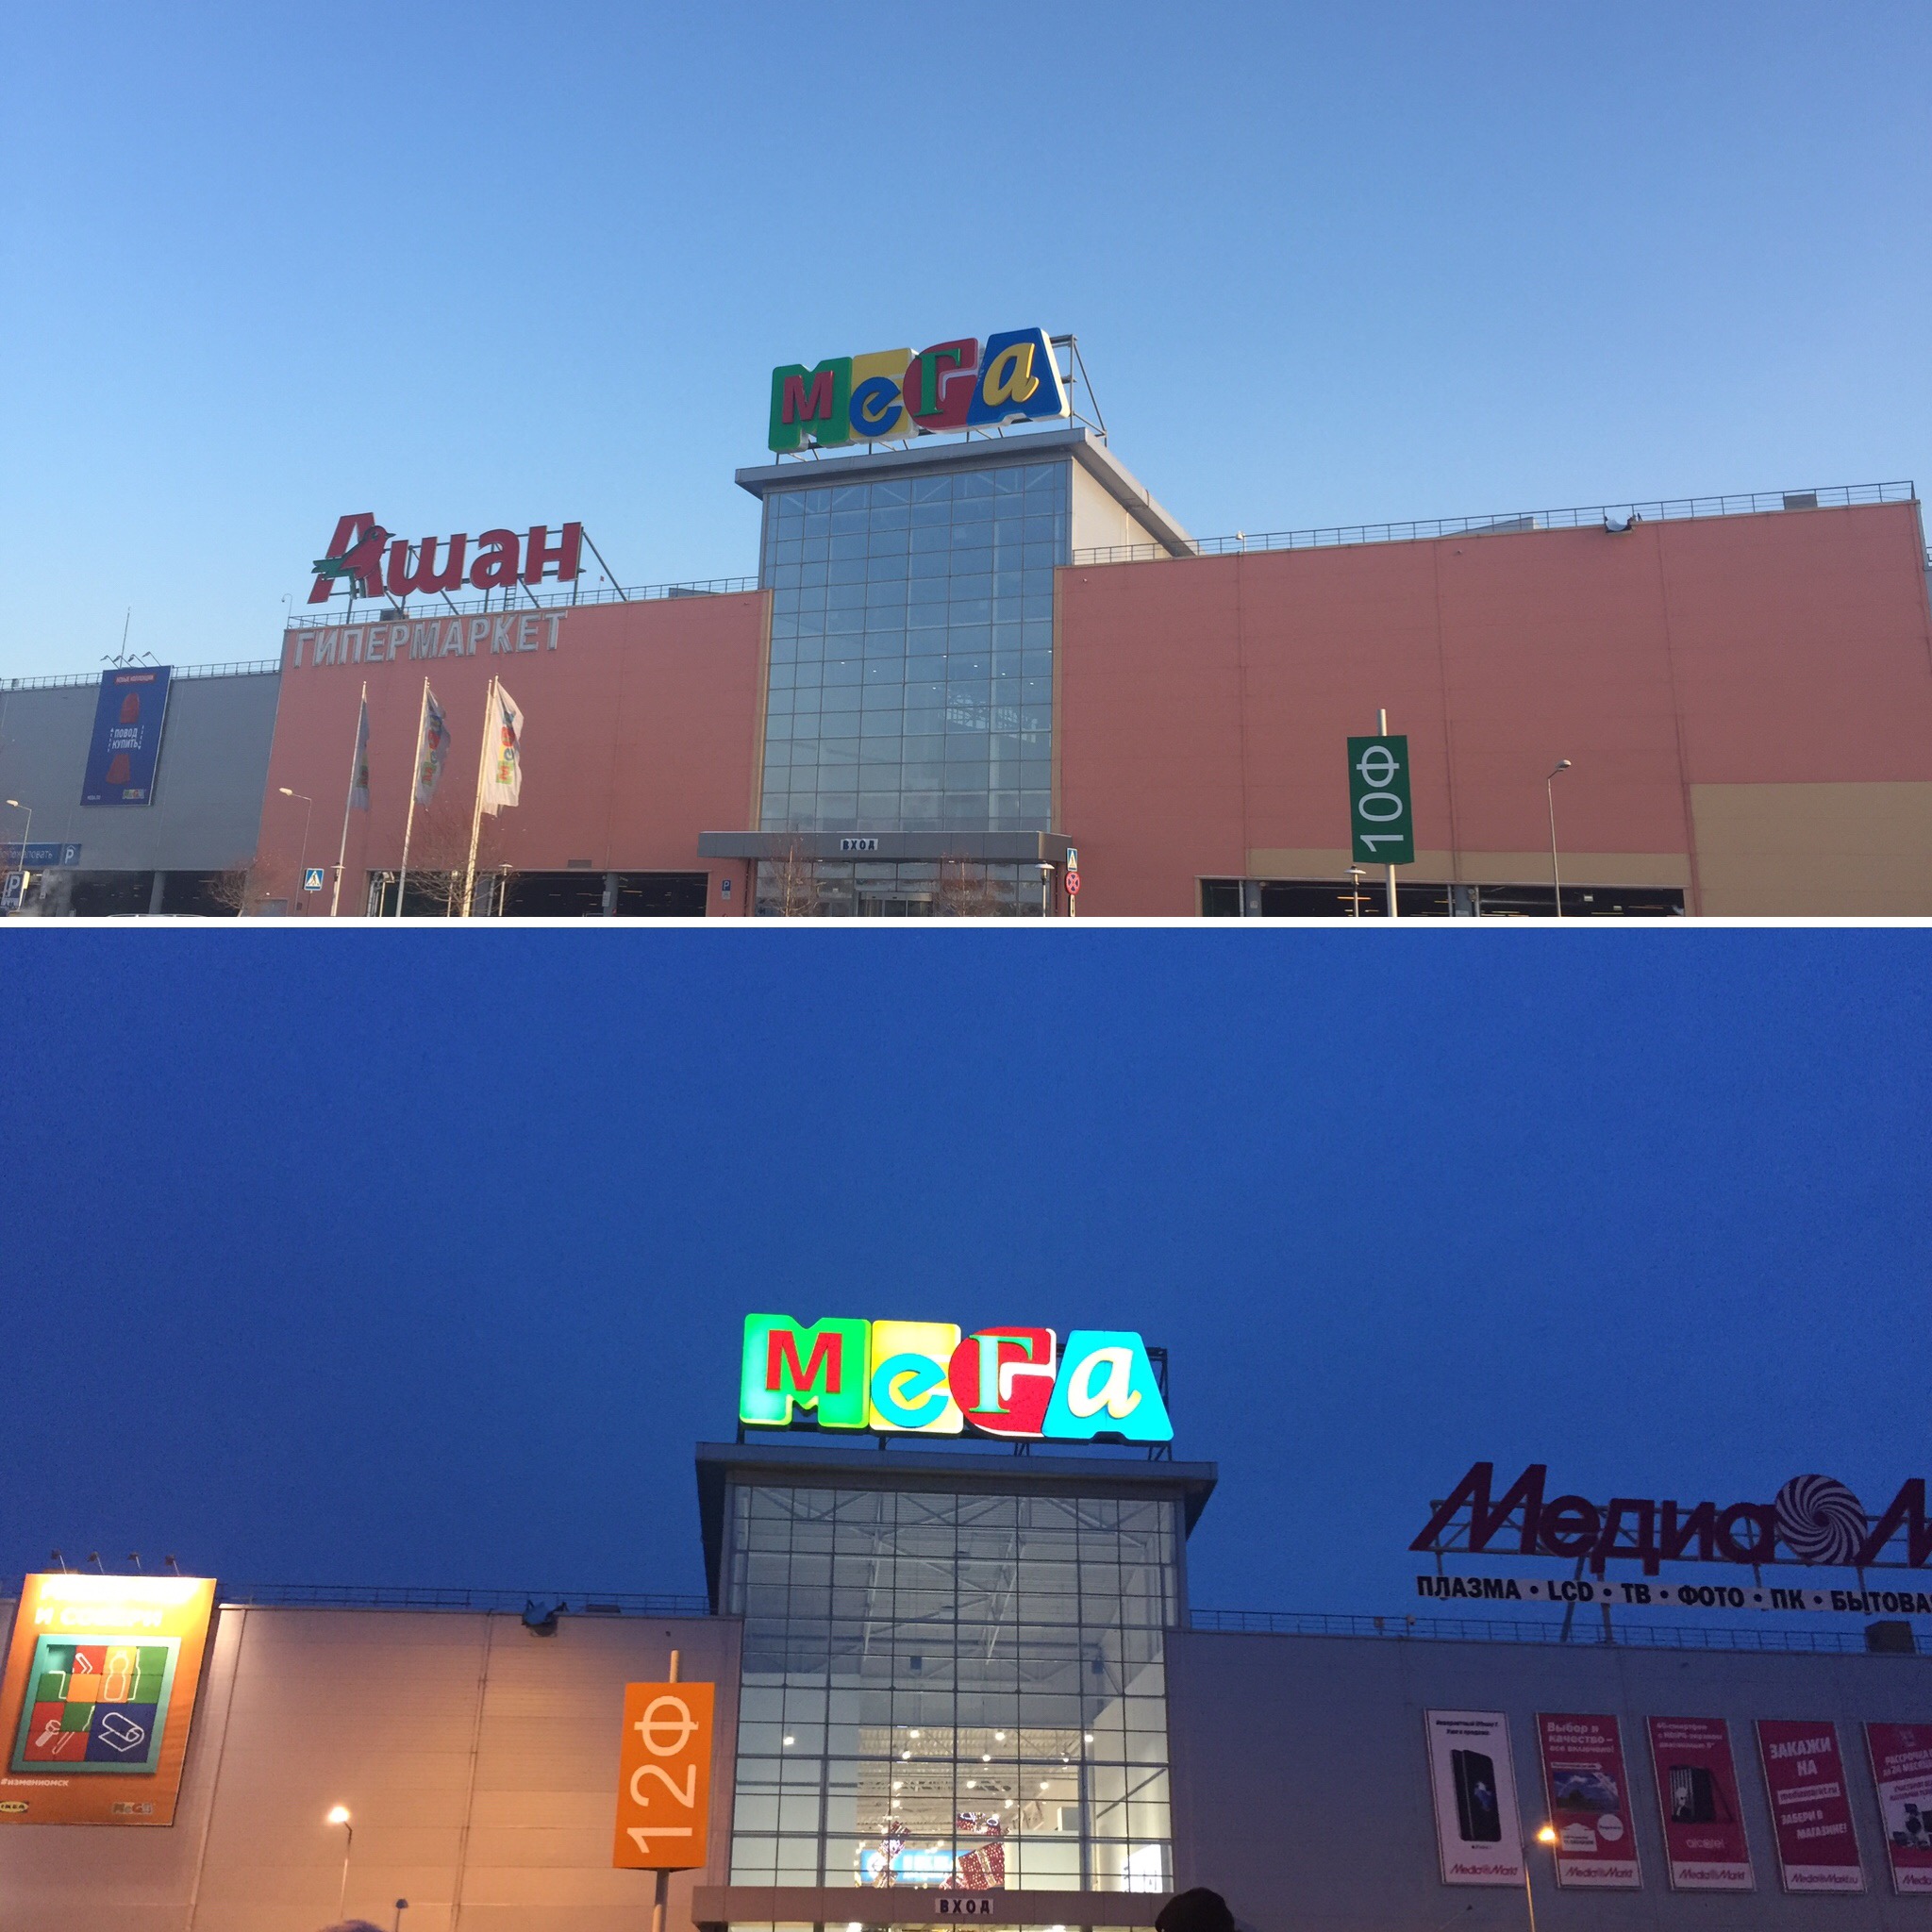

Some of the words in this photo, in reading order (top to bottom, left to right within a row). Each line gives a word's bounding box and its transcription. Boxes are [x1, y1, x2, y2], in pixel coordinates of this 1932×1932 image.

[307, 512, 582, 604] Ашан
[293, 610, 568, 668] ГИПЕРМАРКЕТ
[114, 728, 138, 738] ПОВОД
[112, 739, 139, 749] КУПИТЬ
[1357, 745, 1404, 852] 10Ф
[842, 840, 875, 850] ВХОД
[1417, 1576, 1521, 1600] ПЛАЗМА
[1548, 1581, 1593, 1602] LCD
[1621, 1583, 1652, 1604] ТВ
[1677, 1585, 1744, 1607] ФОТО
[1771, 1588, 1806, 1609] ПК
[1830, 1591, 1932, 1613] БЫТОВА
[1547, 1722, 1589, 1734] Выбор
[1549, 1735, 1605, 1744] качество
[1770, 1737, 1832, 1759] ЗАКАЖИ
[626, 1696, 699, 1853] 12Ф
[1797, 1759, 1818, 1776] НА
[940, 1899, 991, 1914] ВХОД
